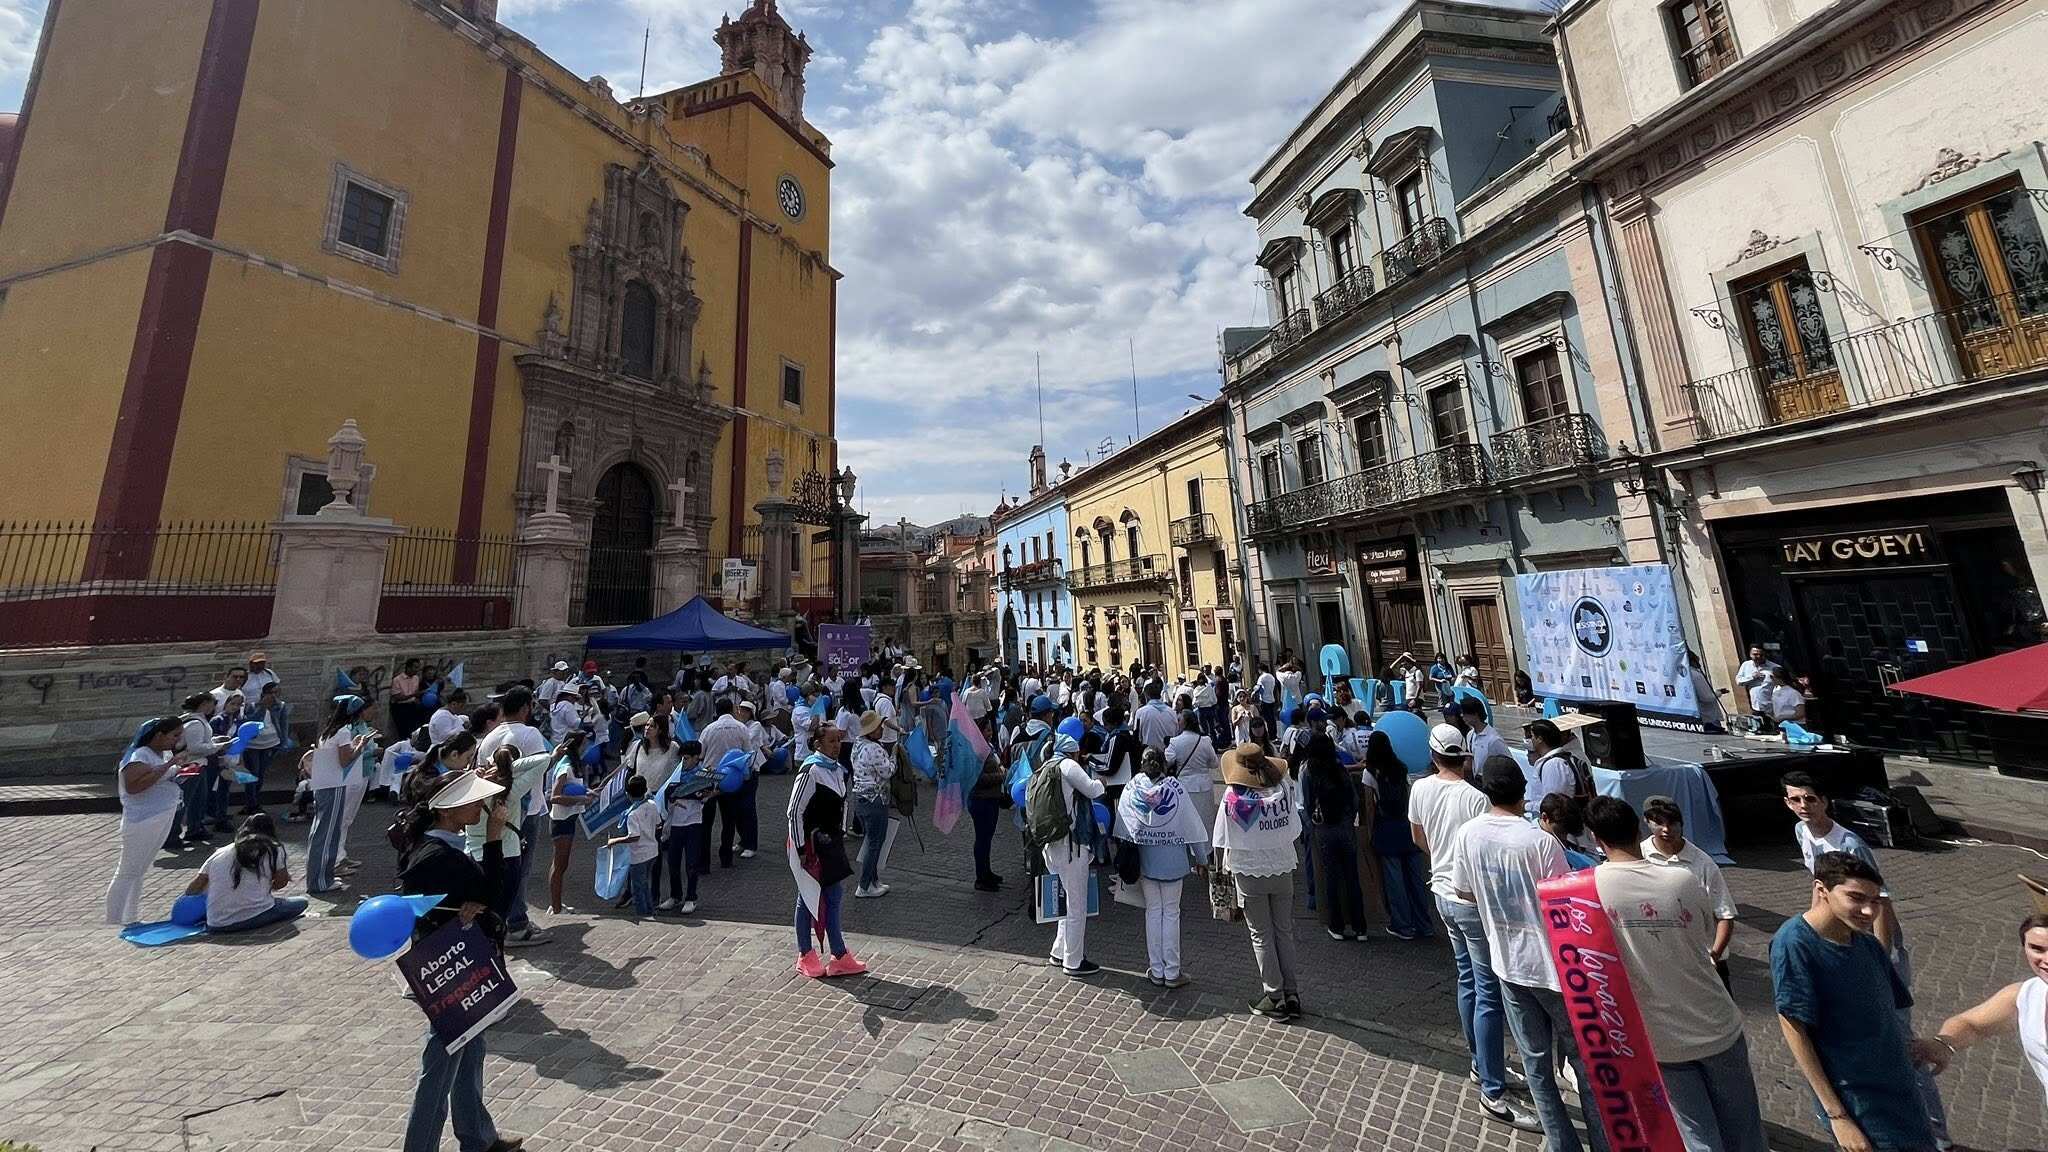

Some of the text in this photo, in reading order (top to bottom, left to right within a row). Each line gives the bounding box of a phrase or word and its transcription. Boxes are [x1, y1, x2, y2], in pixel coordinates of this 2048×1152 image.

[1307, 550, 1329, 567] flexi
[1783, 533, 1925, 562] ¡AY GÜEY!
[1259, 816, 1289, 830] DOLORES
[420, 941, 466, 980] Aborto
[426, 956, 474, 994] LEGAL
[460, 979, 499, 1011] REAL
